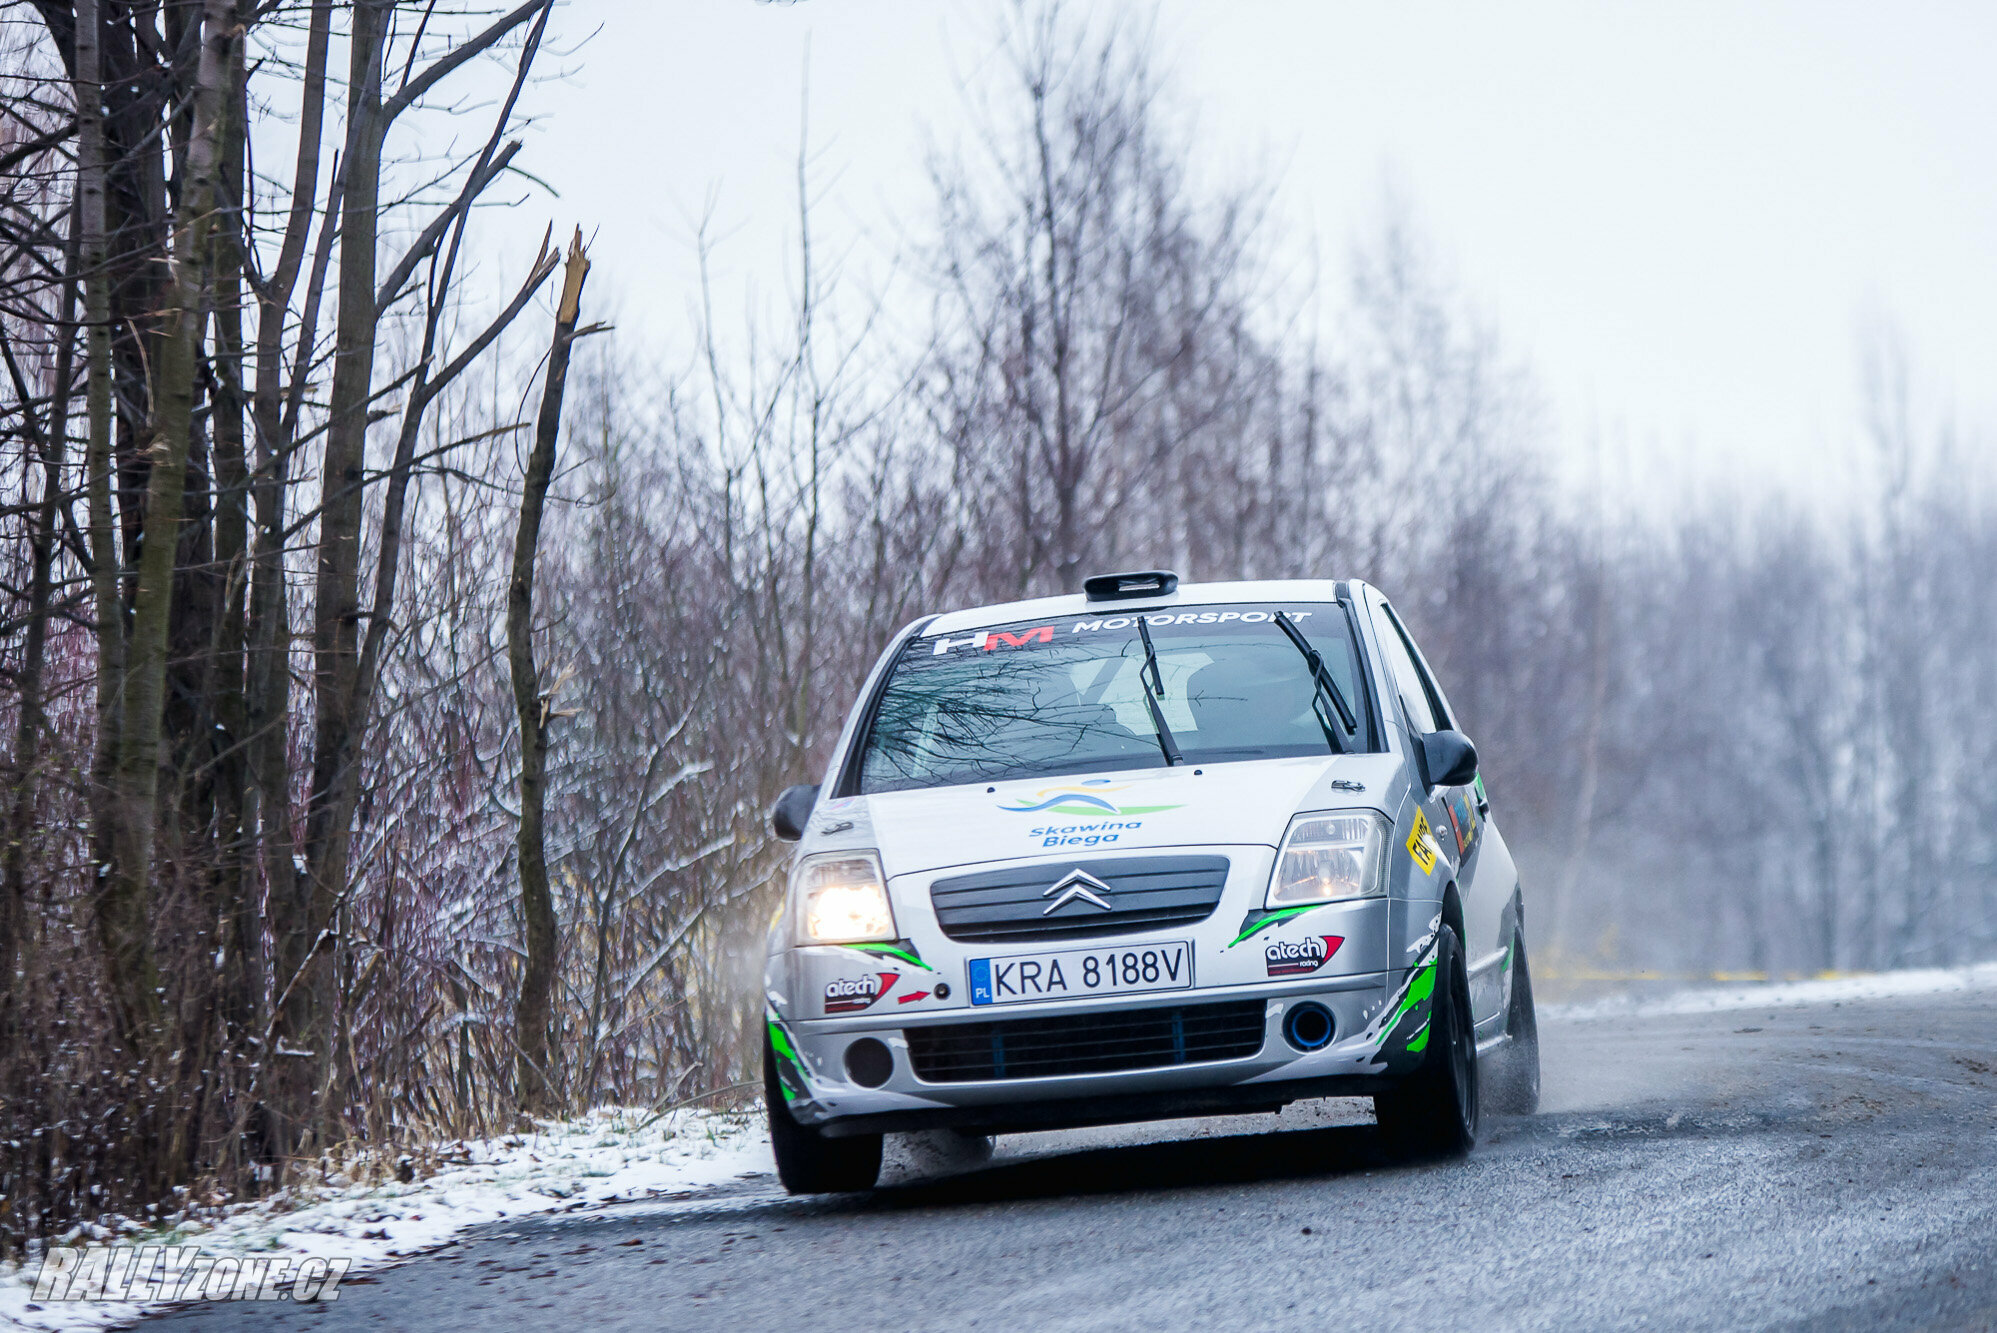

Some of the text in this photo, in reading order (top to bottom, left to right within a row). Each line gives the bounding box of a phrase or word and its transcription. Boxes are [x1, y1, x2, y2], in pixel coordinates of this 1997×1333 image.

[932, 625, 1055, 656] HM
[1029, 821, 1143, 837] Skawina
[1042, 833, 1120, 848] Biega
[1266, 937, 1321, 961] atech
[994, 948, 1183, 996] KRA 8188V
[825, 975, 876, 998] atech
[975, 988, 991, 999] PL
